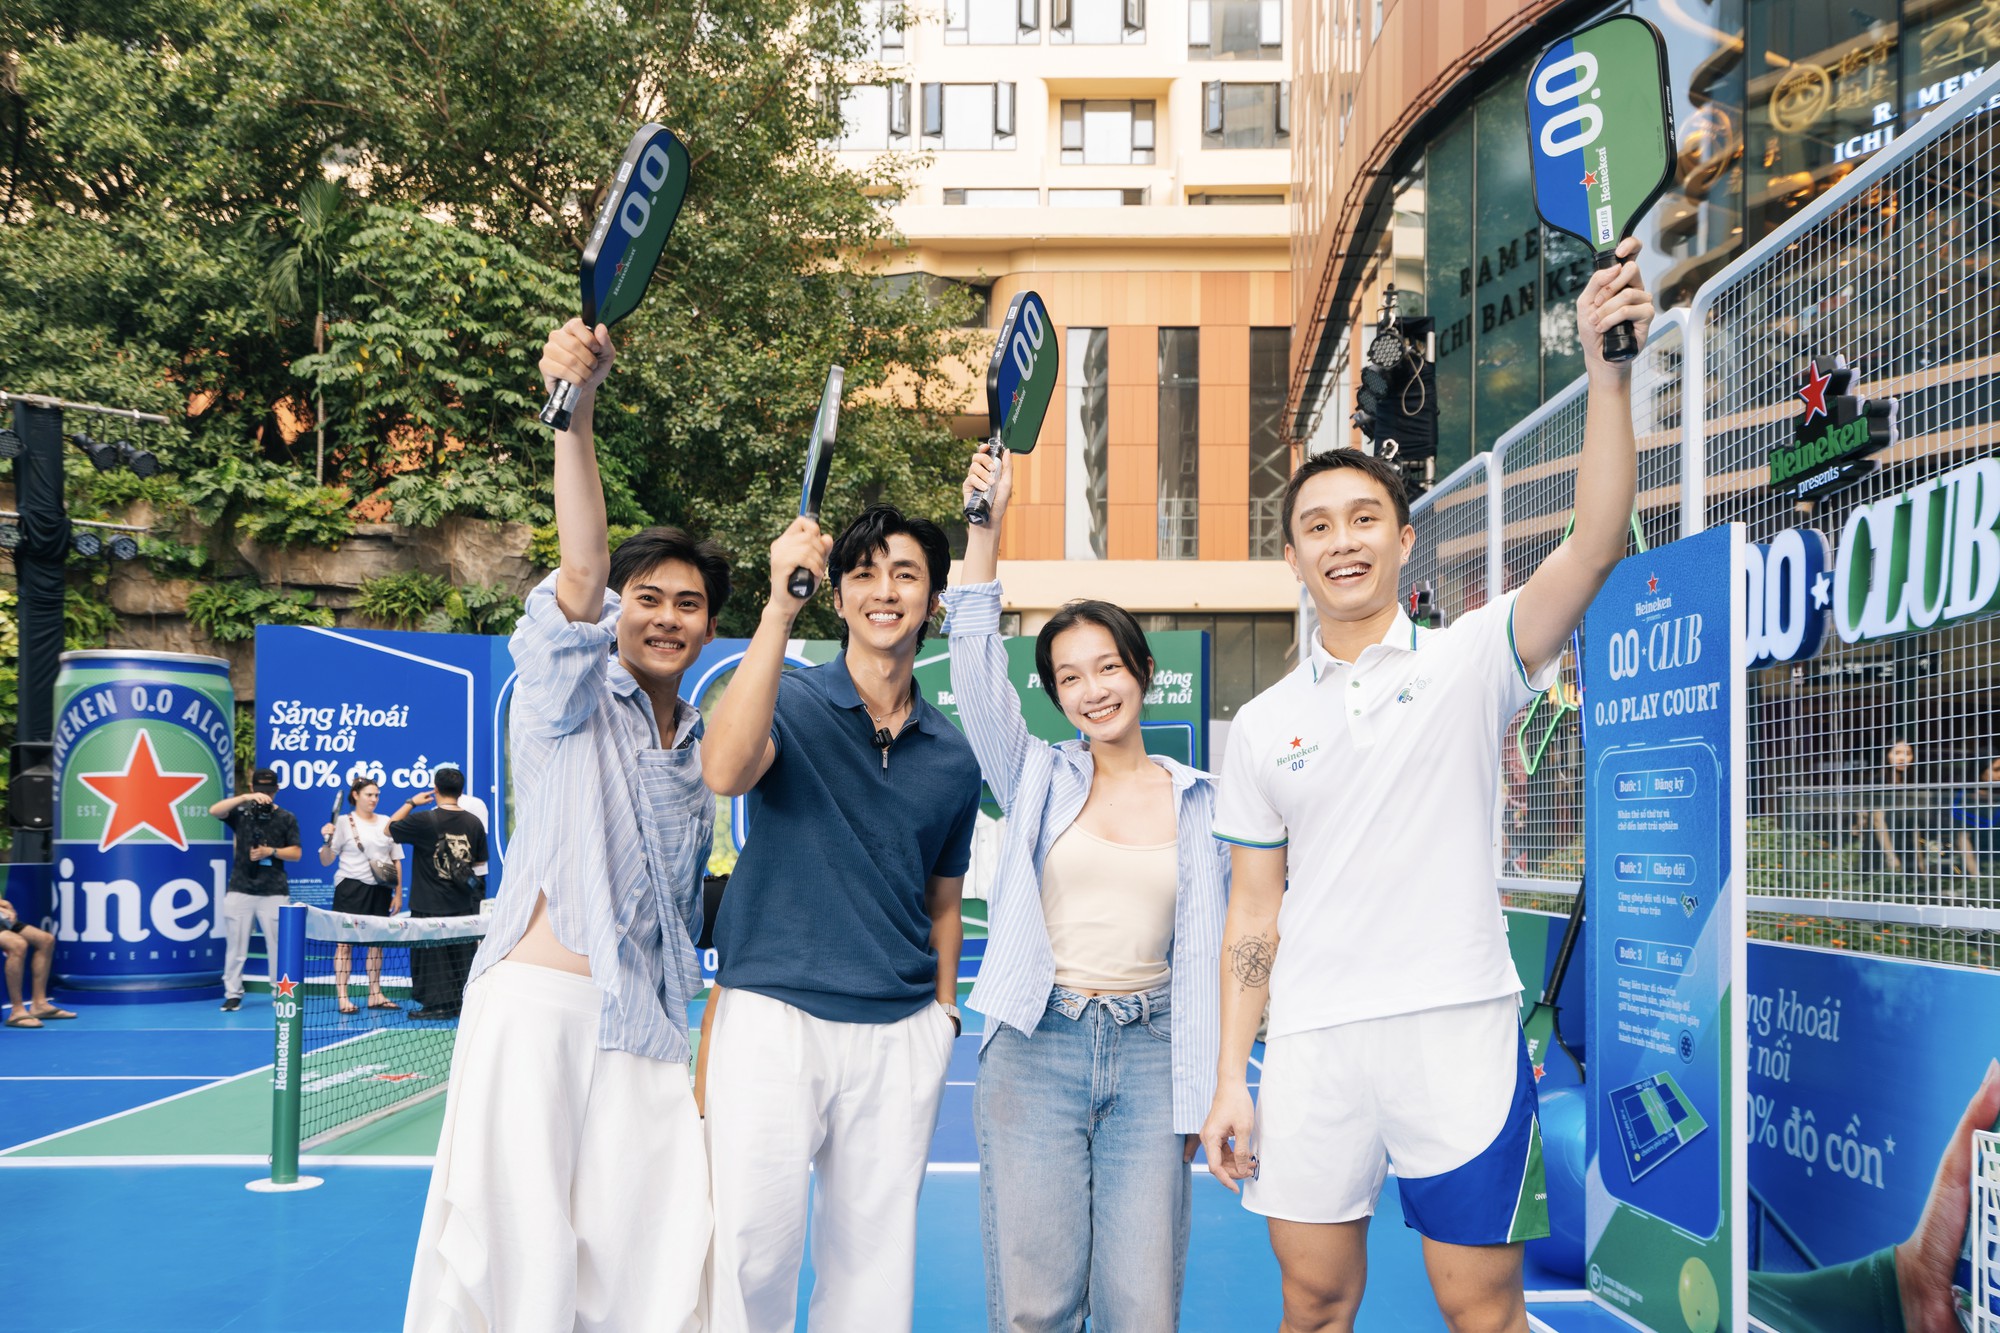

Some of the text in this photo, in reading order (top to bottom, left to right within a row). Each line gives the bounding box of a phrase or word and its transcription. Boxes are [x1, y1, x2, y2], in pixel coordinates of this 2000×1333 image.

[1535, 51, 1603, 157] 0.0
[620, 143, 670, 238] 0.0
[1596, 147, 1611, 203] Heineken
[1013, 300, 1044, 381] 0.0
[1769, 415, 1870, 486] Heineken
[1797, 465, 1840, 497] presents
[1833, 457, 2000, 644] CLUB
[1635, 597, 1672, 616] Heineken
[1648, 613, 1703, 672] CLUB
[131, 686, 173, 713] 0.0
[1167, 687, 1193, 704] nối
[1595, 682, 1721, 727] 0.0 PLAY COURT
[269, 700, 410, 731] Sảng khoái
[270, 725, 357, 753] kết nối
[1276, 744, 1319, 767] Heineken
[1619, 776, 1684, 792] Bước 1 Đăng ký
[77, 805, 101, 816] EST.
[183, 805, 208, 817] 1873
[1619, 861, 1685, 879] Bước 2 Ghép đội
[1637, 949, 1642, 961] 3
[1656, 950, 1669, 964] Kết
[1670, 951, 1683, 967] nối
[276, 1002, 296, 1018] 0.0
[1747, 987, 1841, 1043] ng khoái
[275, 1021, 290, 1091] Heineken
[1757, 1034, 1792, 1083] nối
[1783, 1106, 1819, 1178] độ
[1825, 1113, 1885, 1190] cồn
